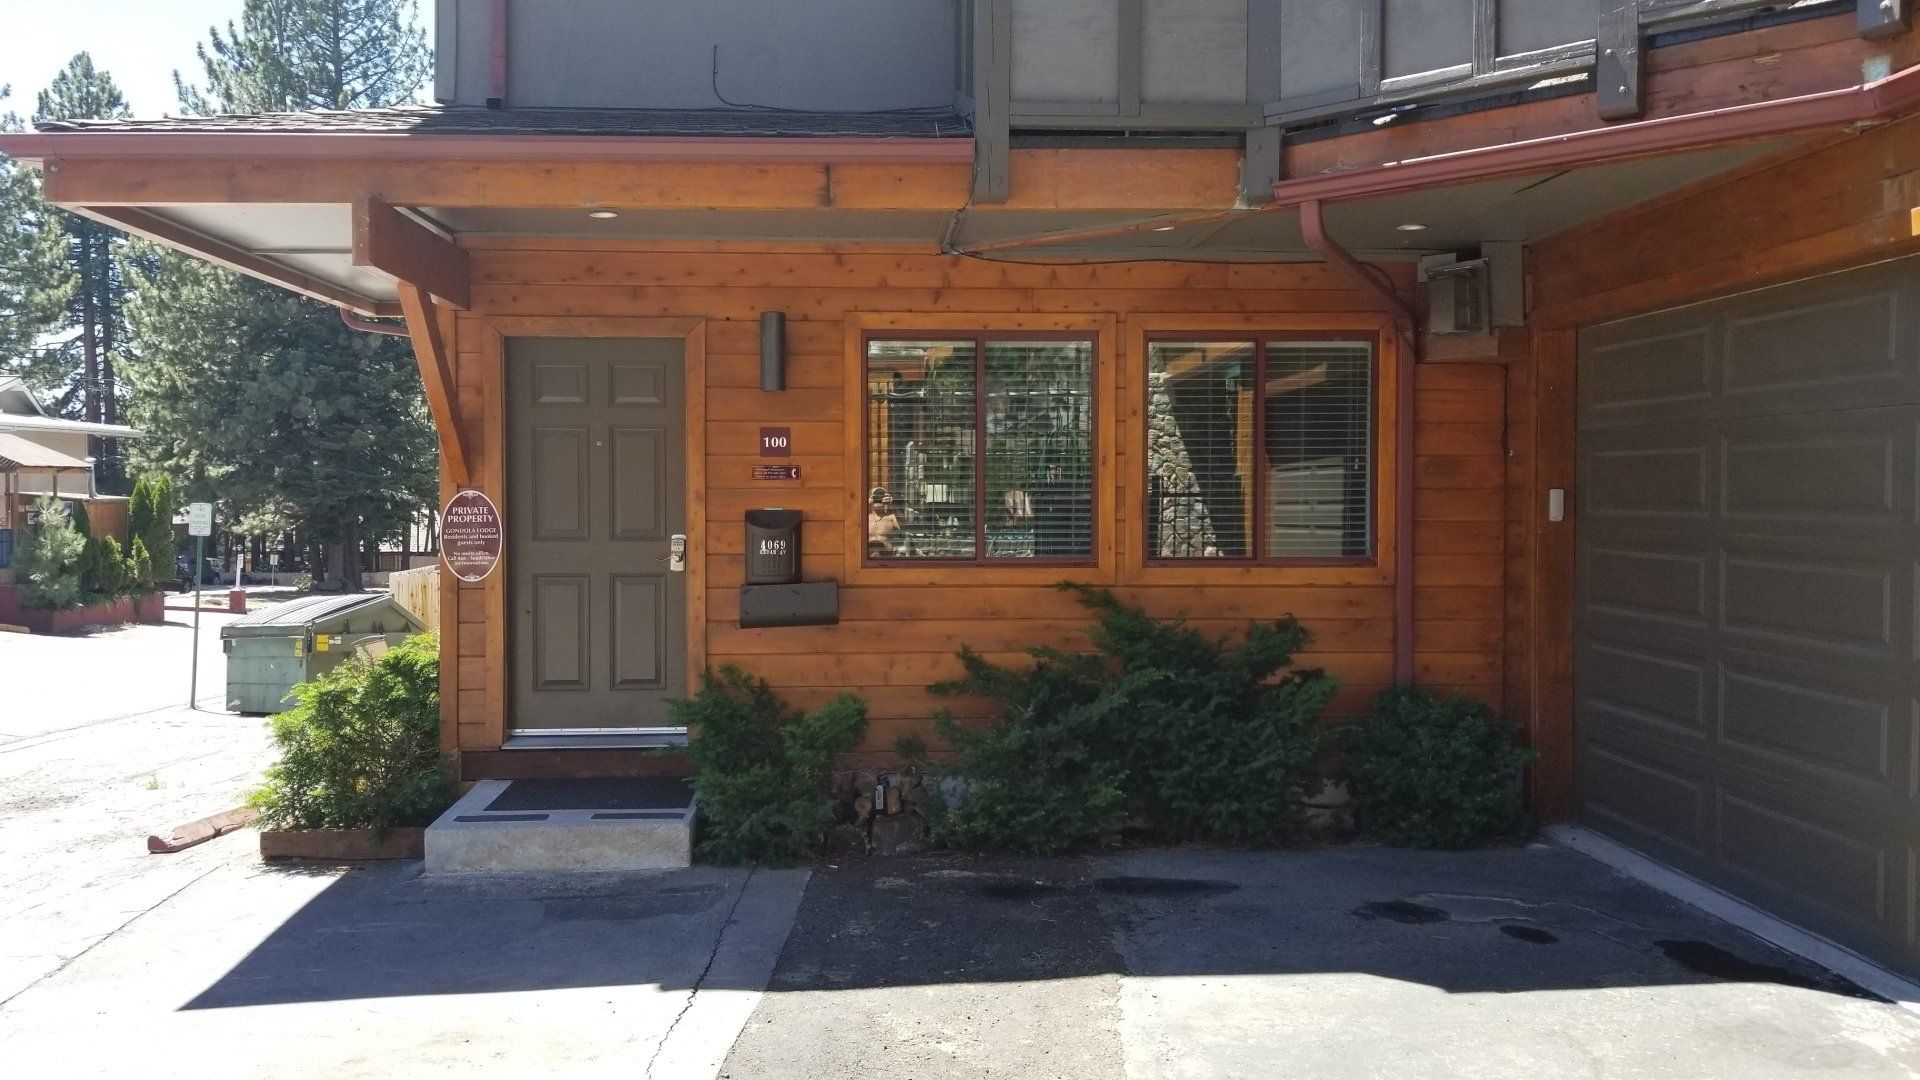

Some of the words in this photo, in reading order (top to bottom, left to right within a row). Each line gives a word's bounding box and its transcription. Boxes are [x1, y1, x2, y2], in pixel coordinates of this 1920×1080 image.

[763, 436, 787, 448] 100
[452, 506, 489, 515] PRIVATE
[447, 514, 494, 523] PROPERTY
[760, 539, 786, 550] 4069
